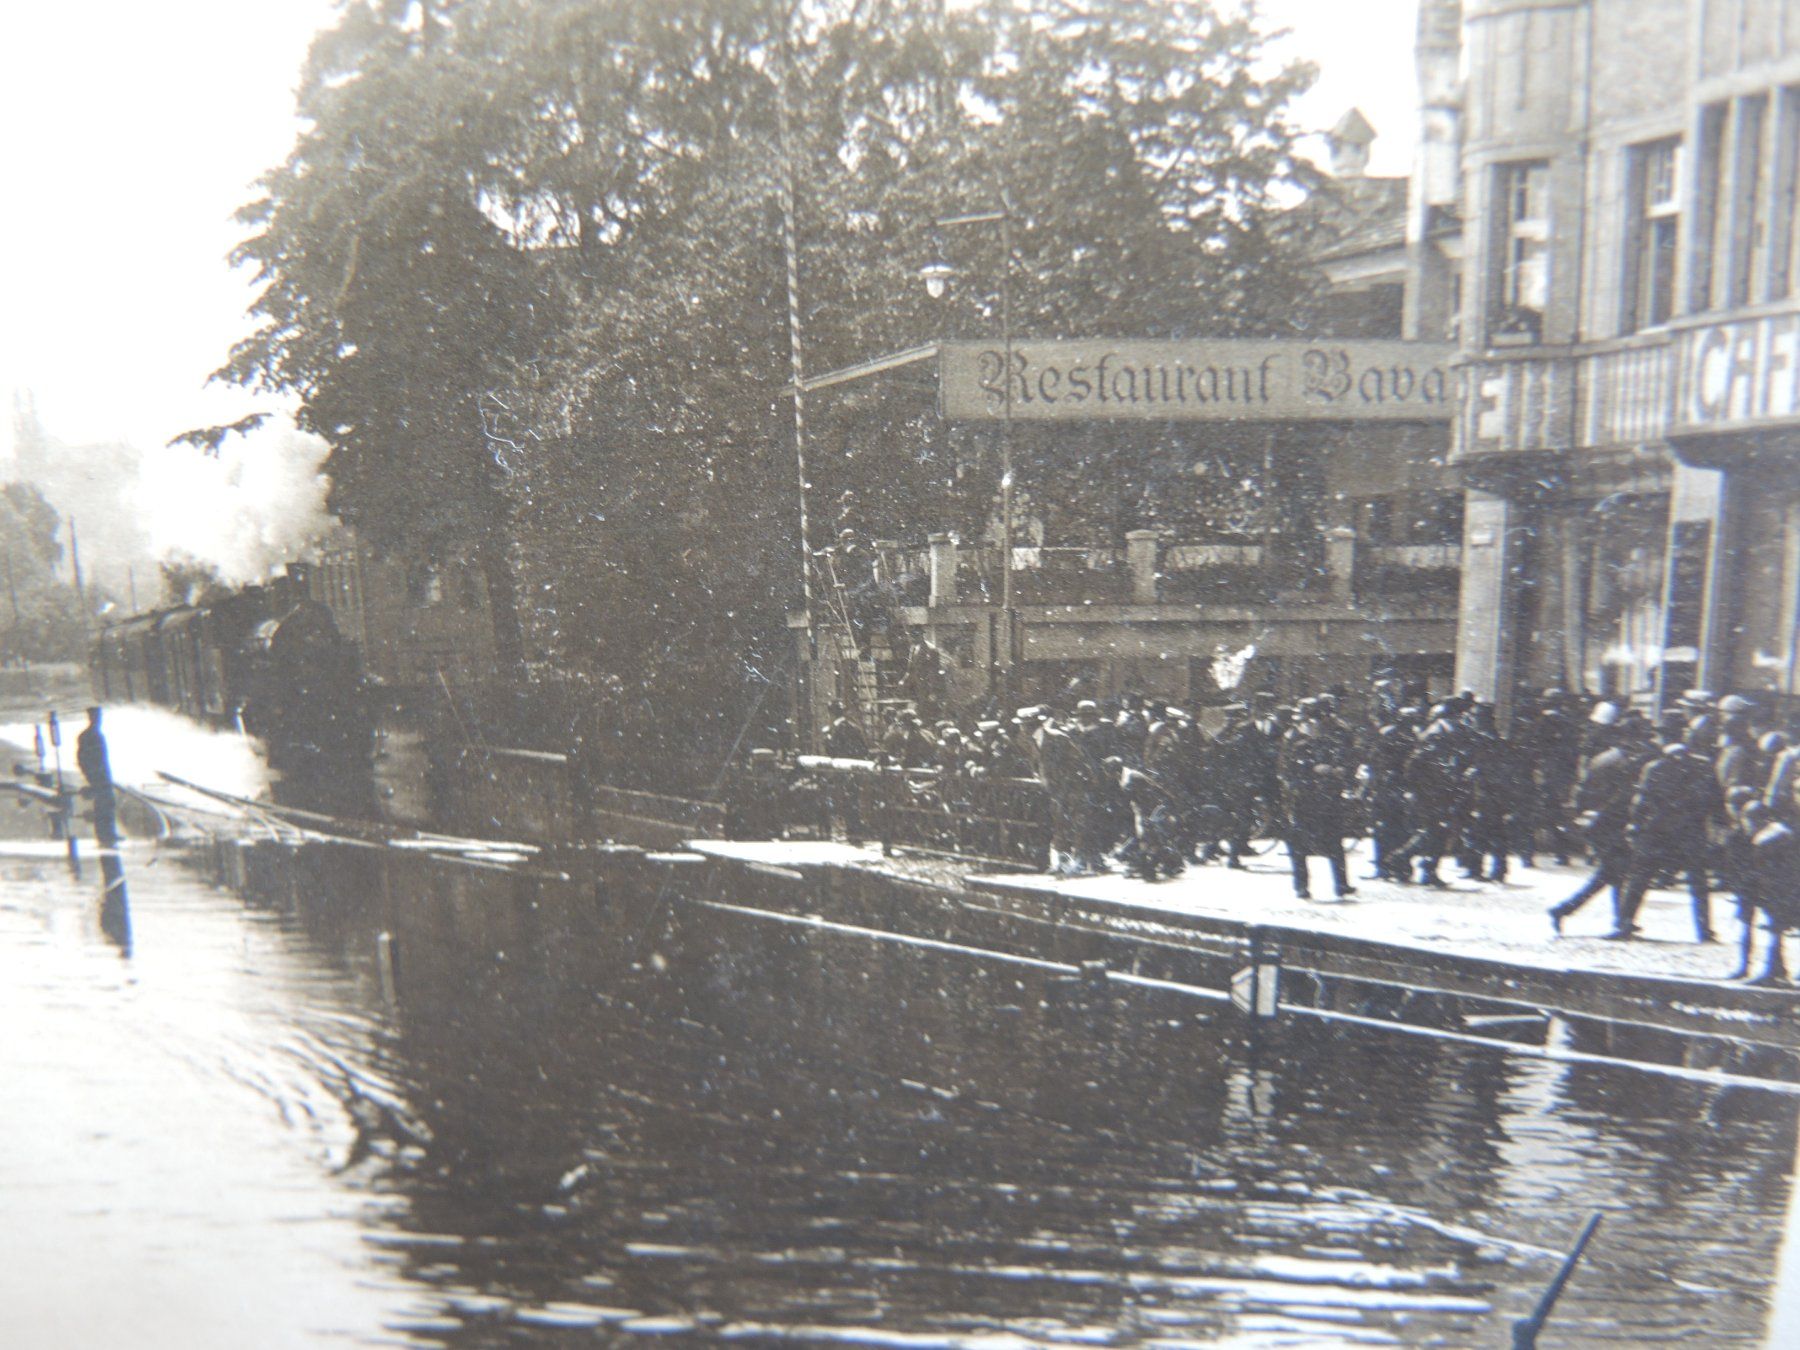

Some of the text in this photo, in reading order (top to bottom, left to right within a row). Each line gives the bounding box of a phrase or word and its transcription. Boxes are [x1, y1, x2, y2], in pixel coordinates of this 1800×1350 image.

[977, 349, 1449, 403] Restaurant Bava
[1695, 317, 1800, 421] CAF
